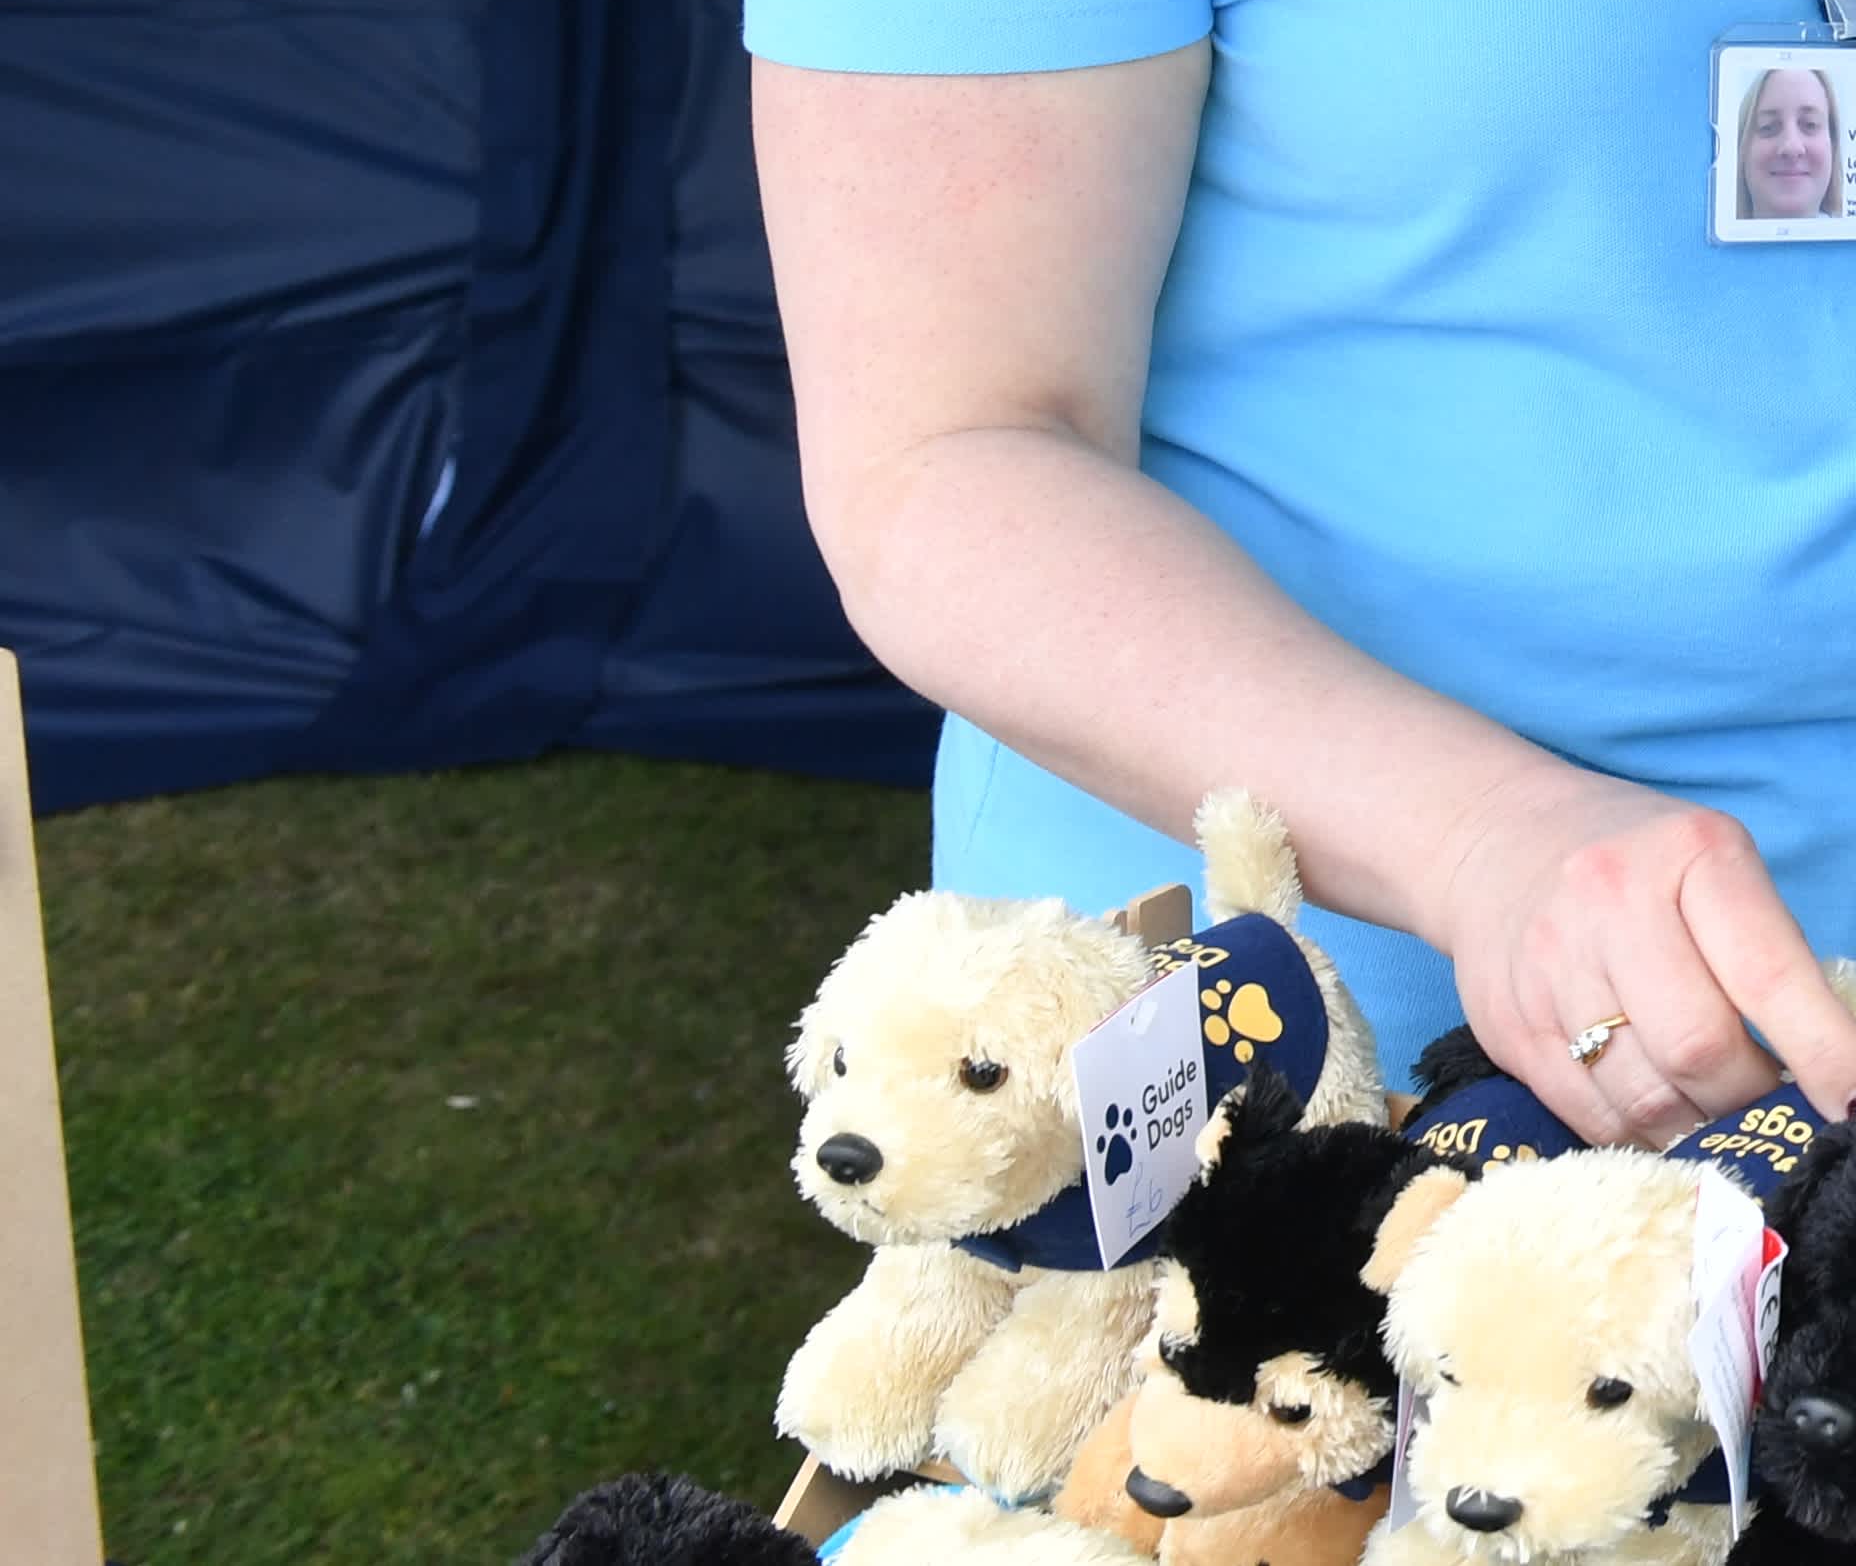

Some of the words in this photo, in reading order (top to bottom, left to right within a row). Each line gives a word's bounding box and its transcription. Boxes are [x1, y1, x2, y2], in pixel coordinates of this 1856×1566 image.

[1142, 1059, 1197, 1115] Guide
[1147, 1098, 1193, 1151] Dogs
[1739, 1104, 1817, 1154] ogs
